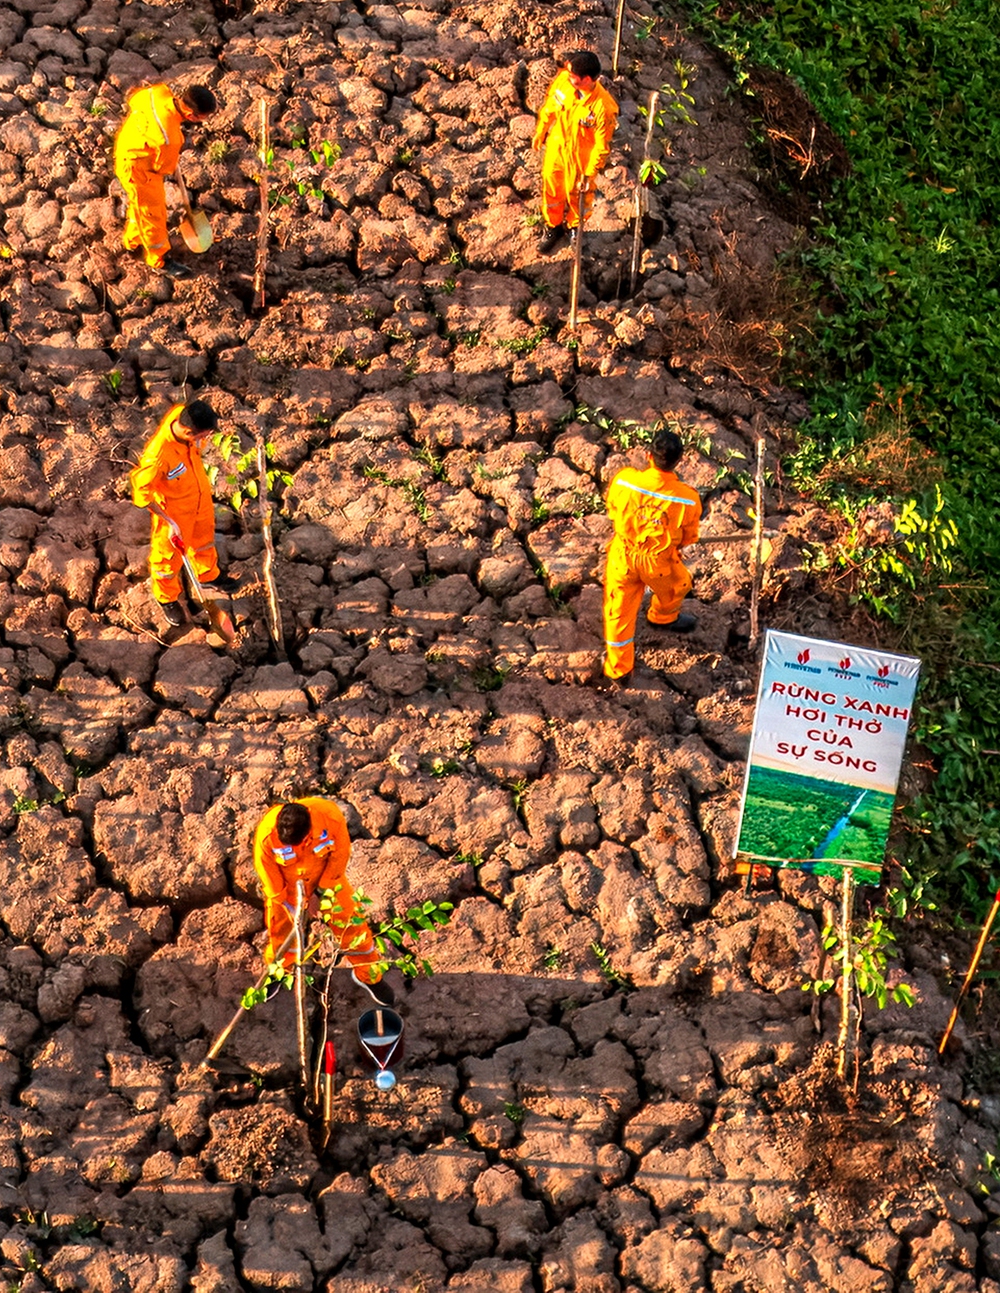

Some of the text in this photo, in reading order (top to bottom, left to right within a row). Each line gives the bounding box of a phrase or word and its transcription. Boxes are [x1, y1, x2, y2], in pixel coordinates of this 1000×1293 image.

[772, 681, 909, 720] RỪNG XANH
[786, 704, 883, 734] HƠI THỞ
[806, 729, 853, 748] CỦA
[776, 742, 878, 772] SỰ SỐNG
